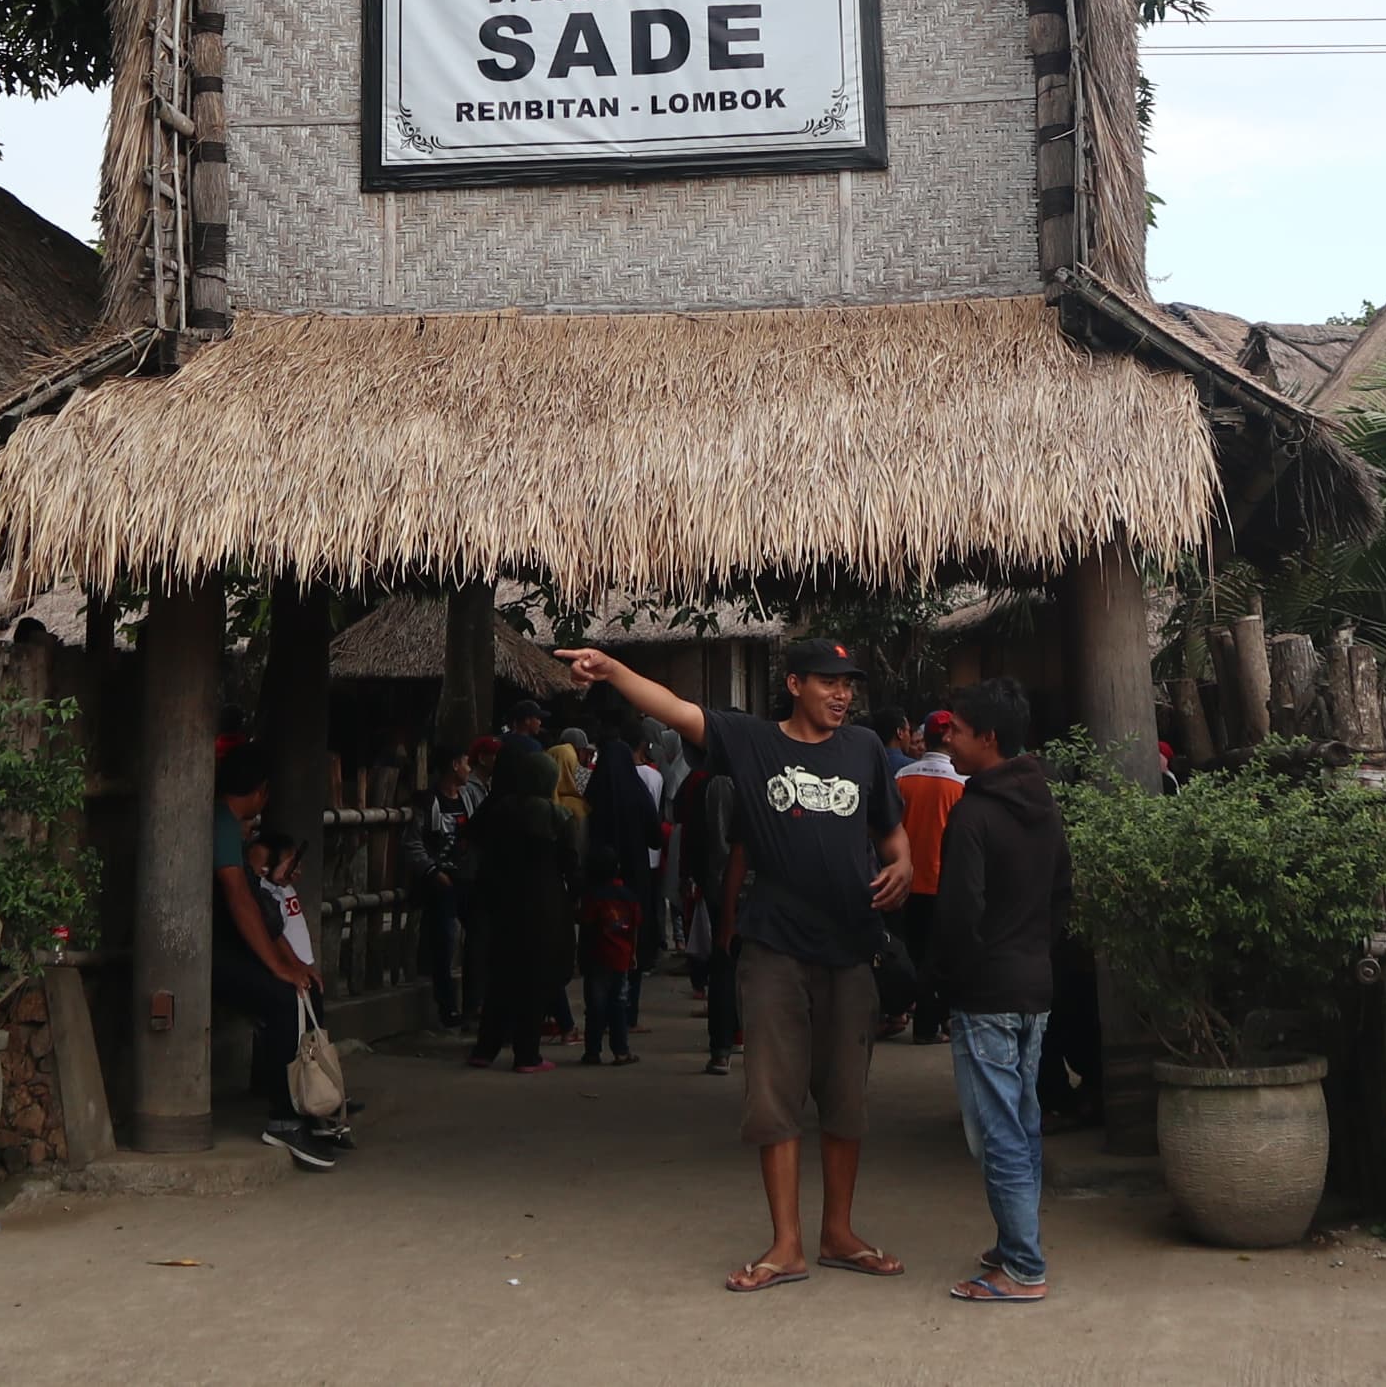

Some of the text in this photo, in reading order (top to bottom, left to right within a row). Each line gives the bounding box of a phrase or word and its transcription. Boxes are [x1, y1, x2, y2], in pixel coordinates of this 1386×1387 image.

[477, 4, 764, 81] SADE
[456, 97, 619, 122] REMBITAN
[649, 88, 786, 114] LOMBOK
